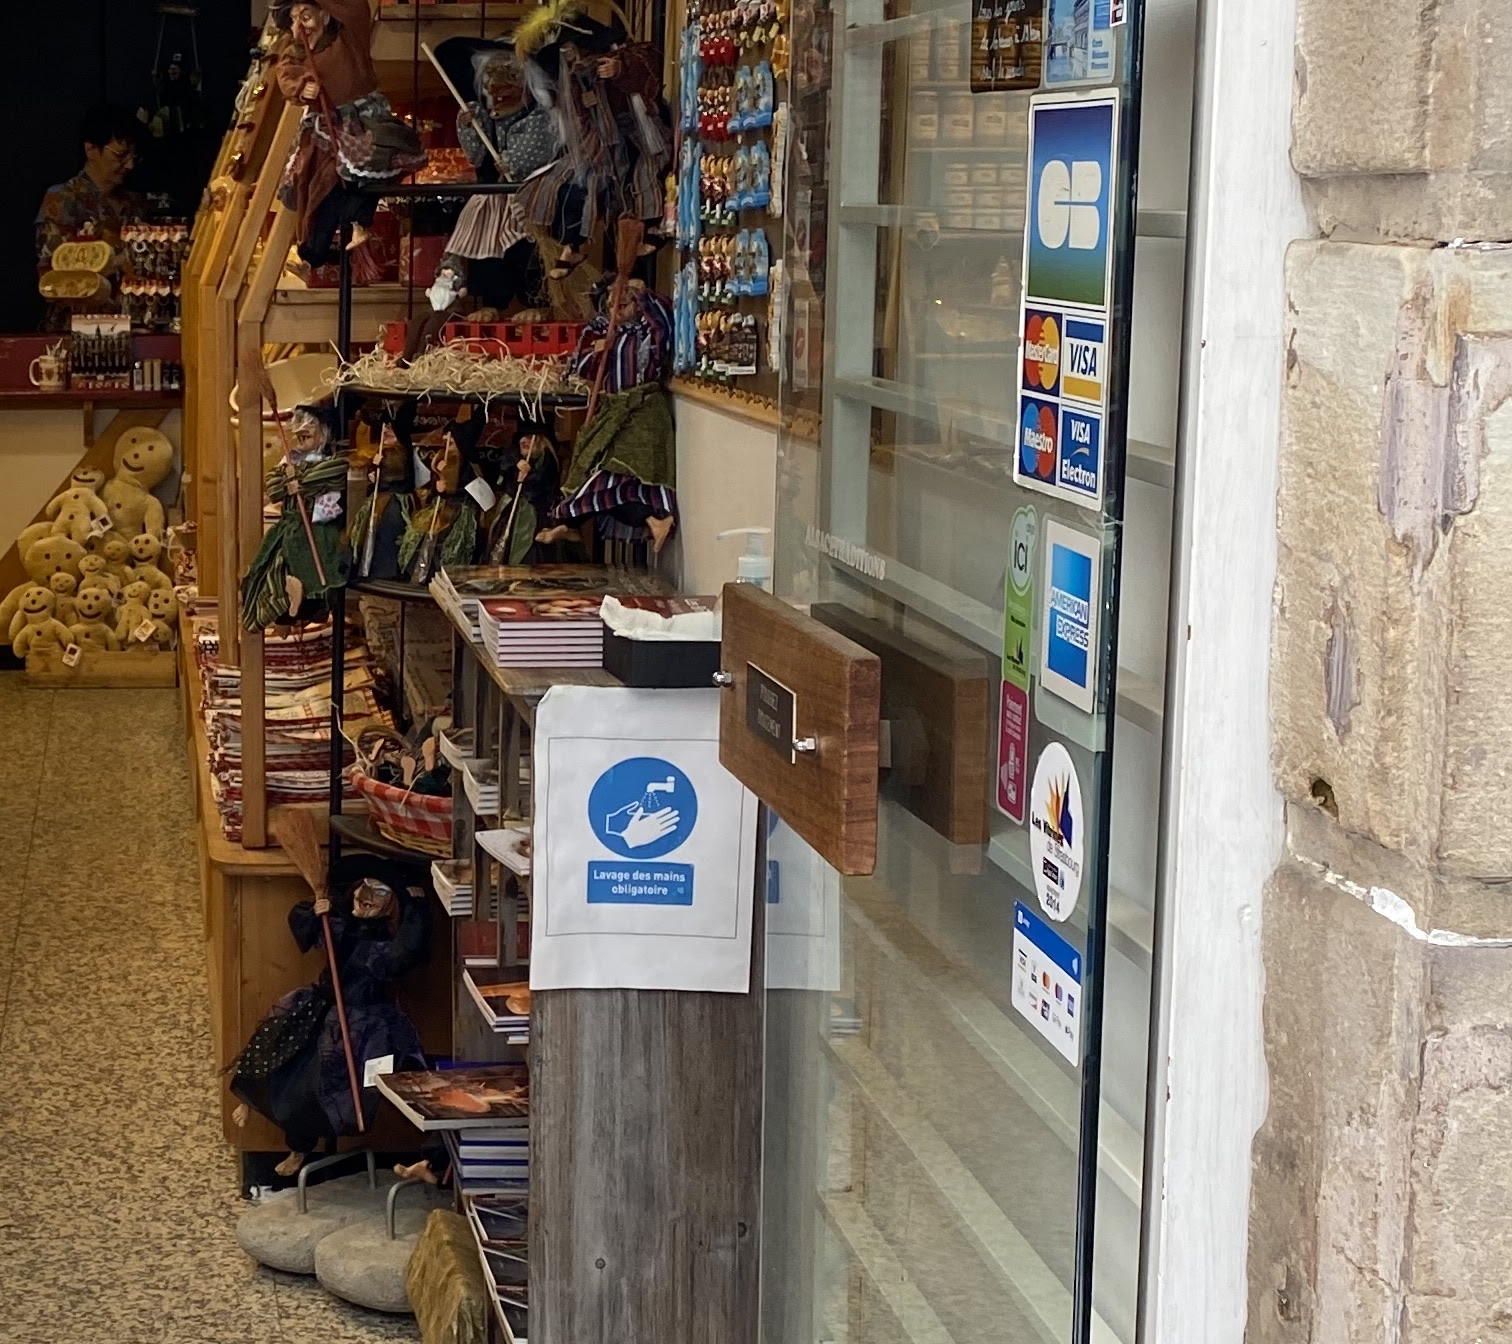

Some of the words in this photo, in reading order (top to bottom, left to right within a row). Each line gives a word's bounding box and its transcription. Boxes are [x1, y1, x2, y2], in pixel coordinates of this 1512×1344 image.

[1038, 159, 1102, 250] CB
[1069, 342, 1098, 377] VISA
[1023, 426, 1054, 455] Maestro
[1070, 418, 1091, 446] VISA
[1061, 458, 1097, 490] Electron
[1050, 586, 1089, 625] AMERICAN
[1056, 615, 1090, 649] EXPRESS
[593, 869, 630, 882] Lavage
[632, 869, 651, 881] des
[653, 870, 686, 883] mains
[611, 883, 669, 897] obligatoire
[1045, 891, 1061, 915] 2014
